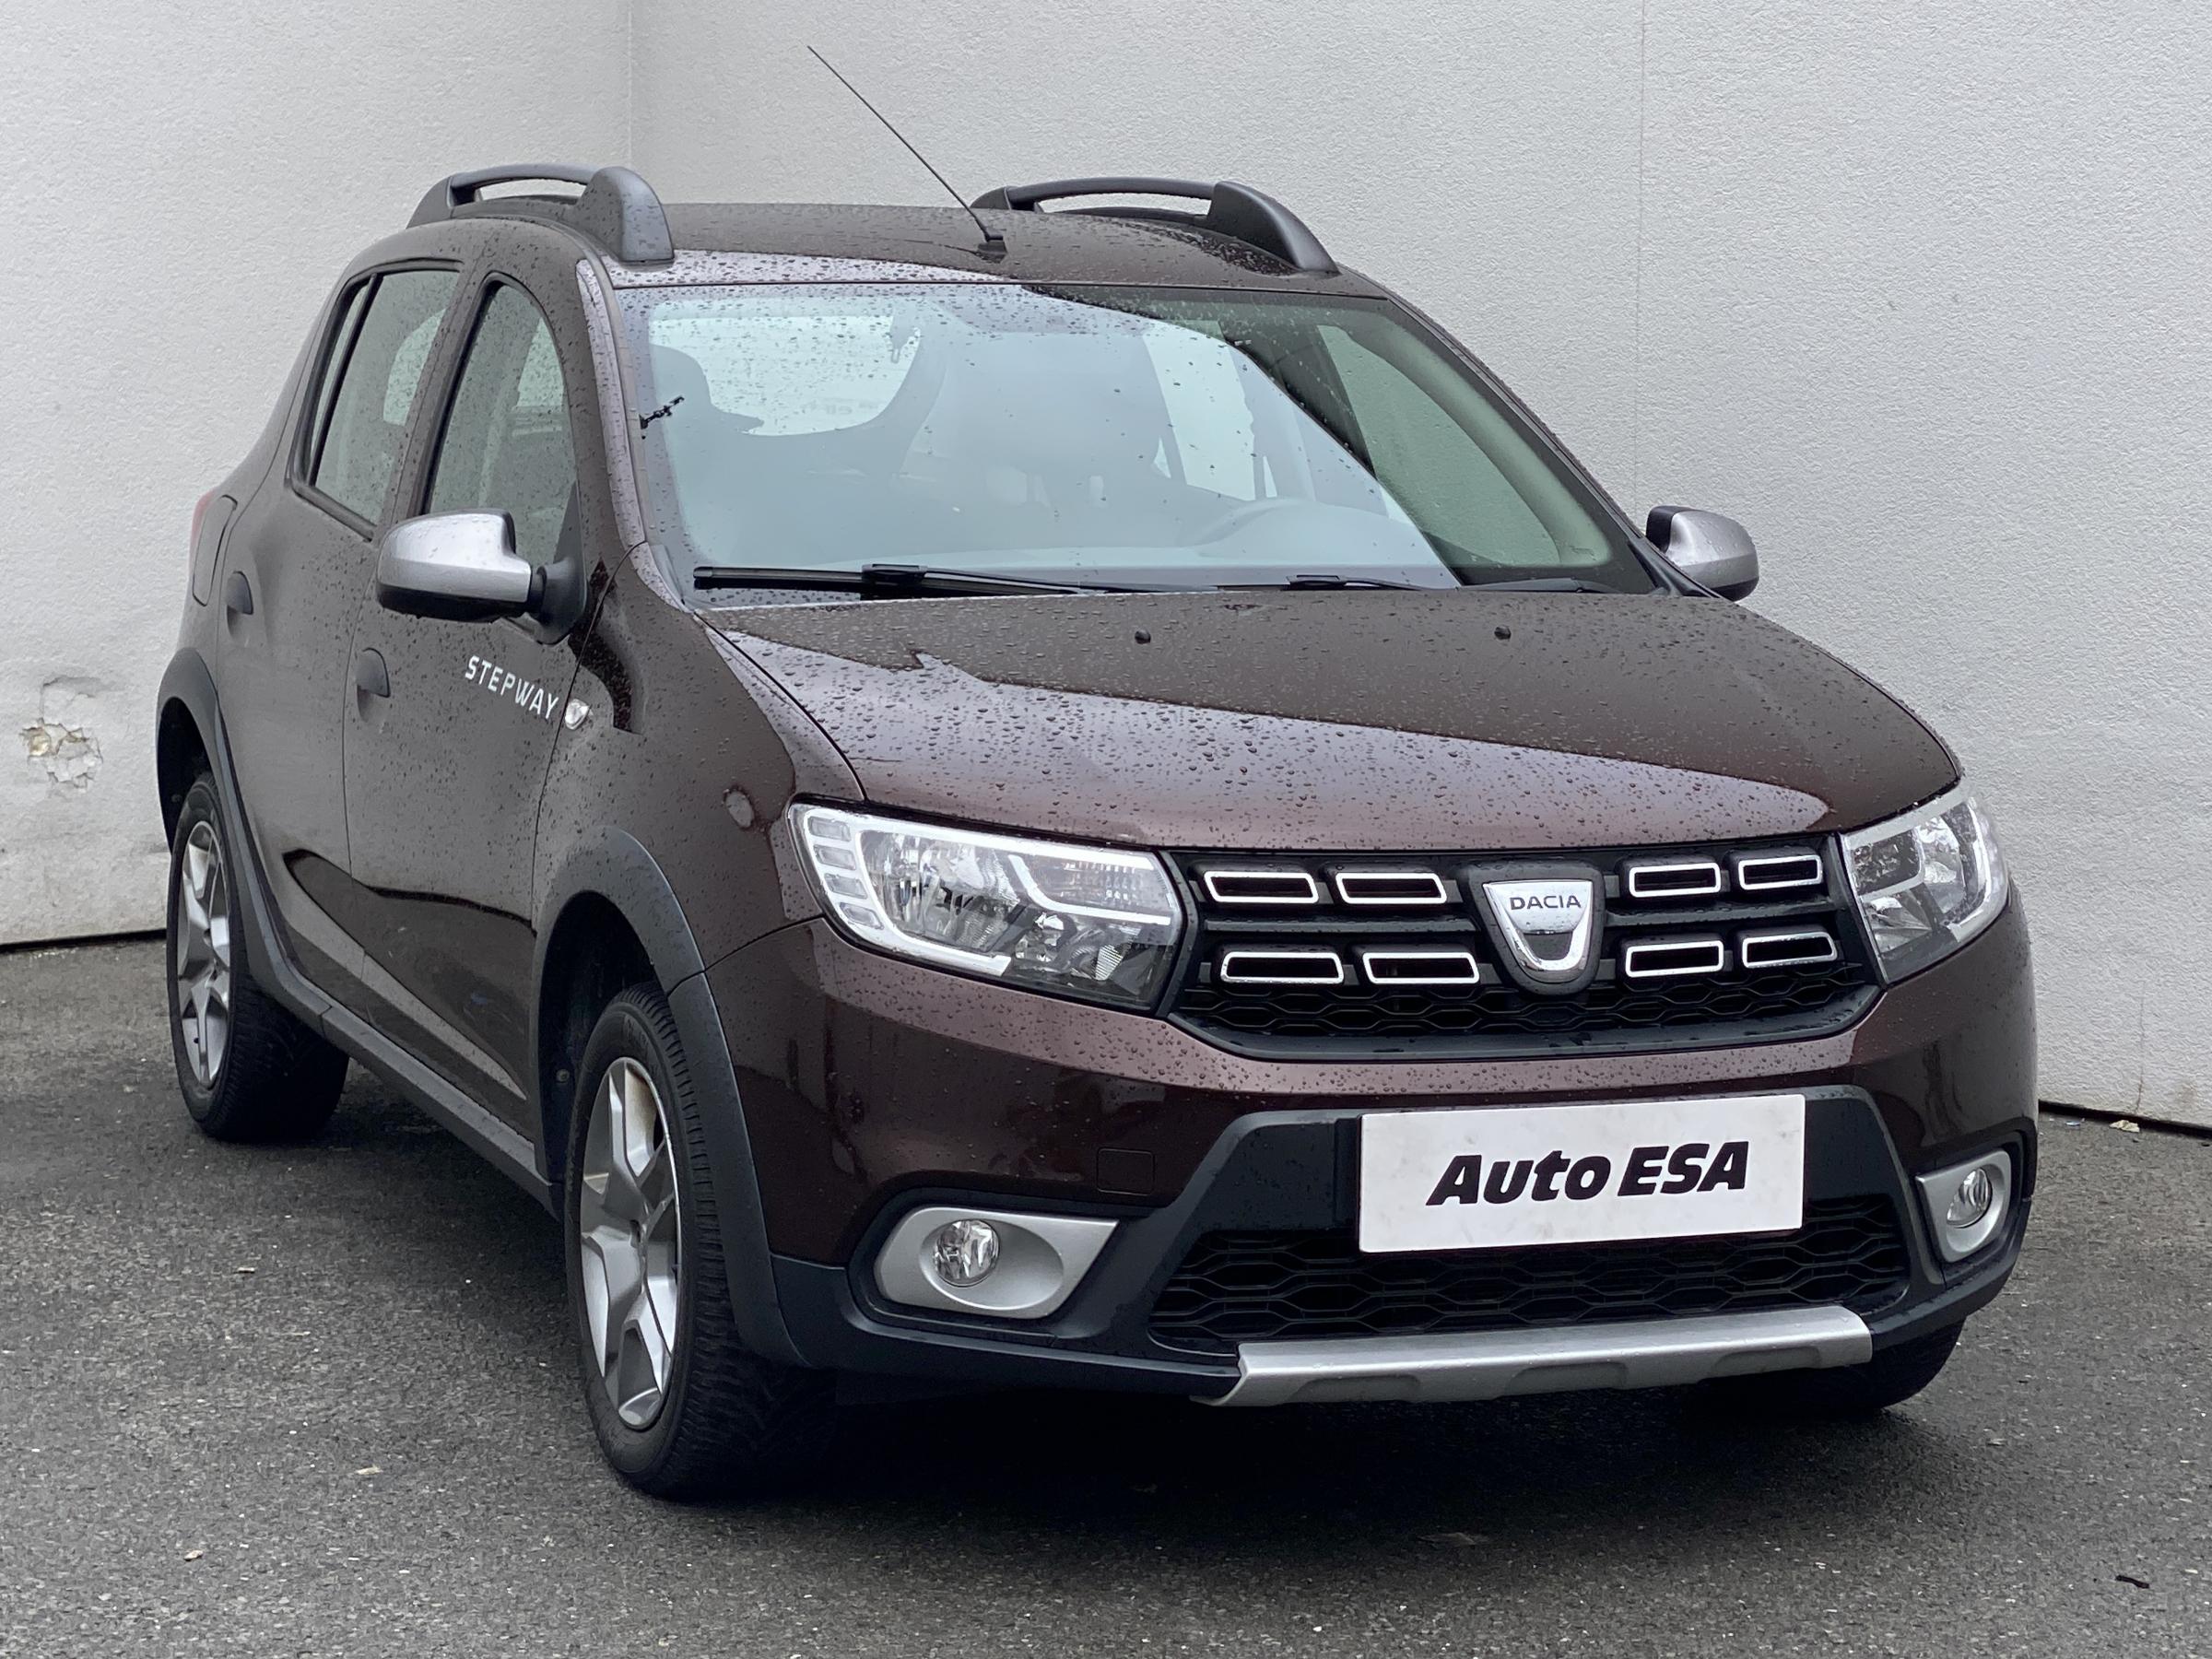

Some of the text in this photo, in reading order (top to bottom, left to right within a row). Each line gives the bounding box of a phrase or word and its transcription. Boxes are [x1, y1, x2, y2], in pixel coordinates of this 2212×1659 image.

[465, 655, 559, 719] STEPWAY
[1510, 895, 1582, 910] DACIA
[1425, 1141, 1748, 1206] Auto ESA
